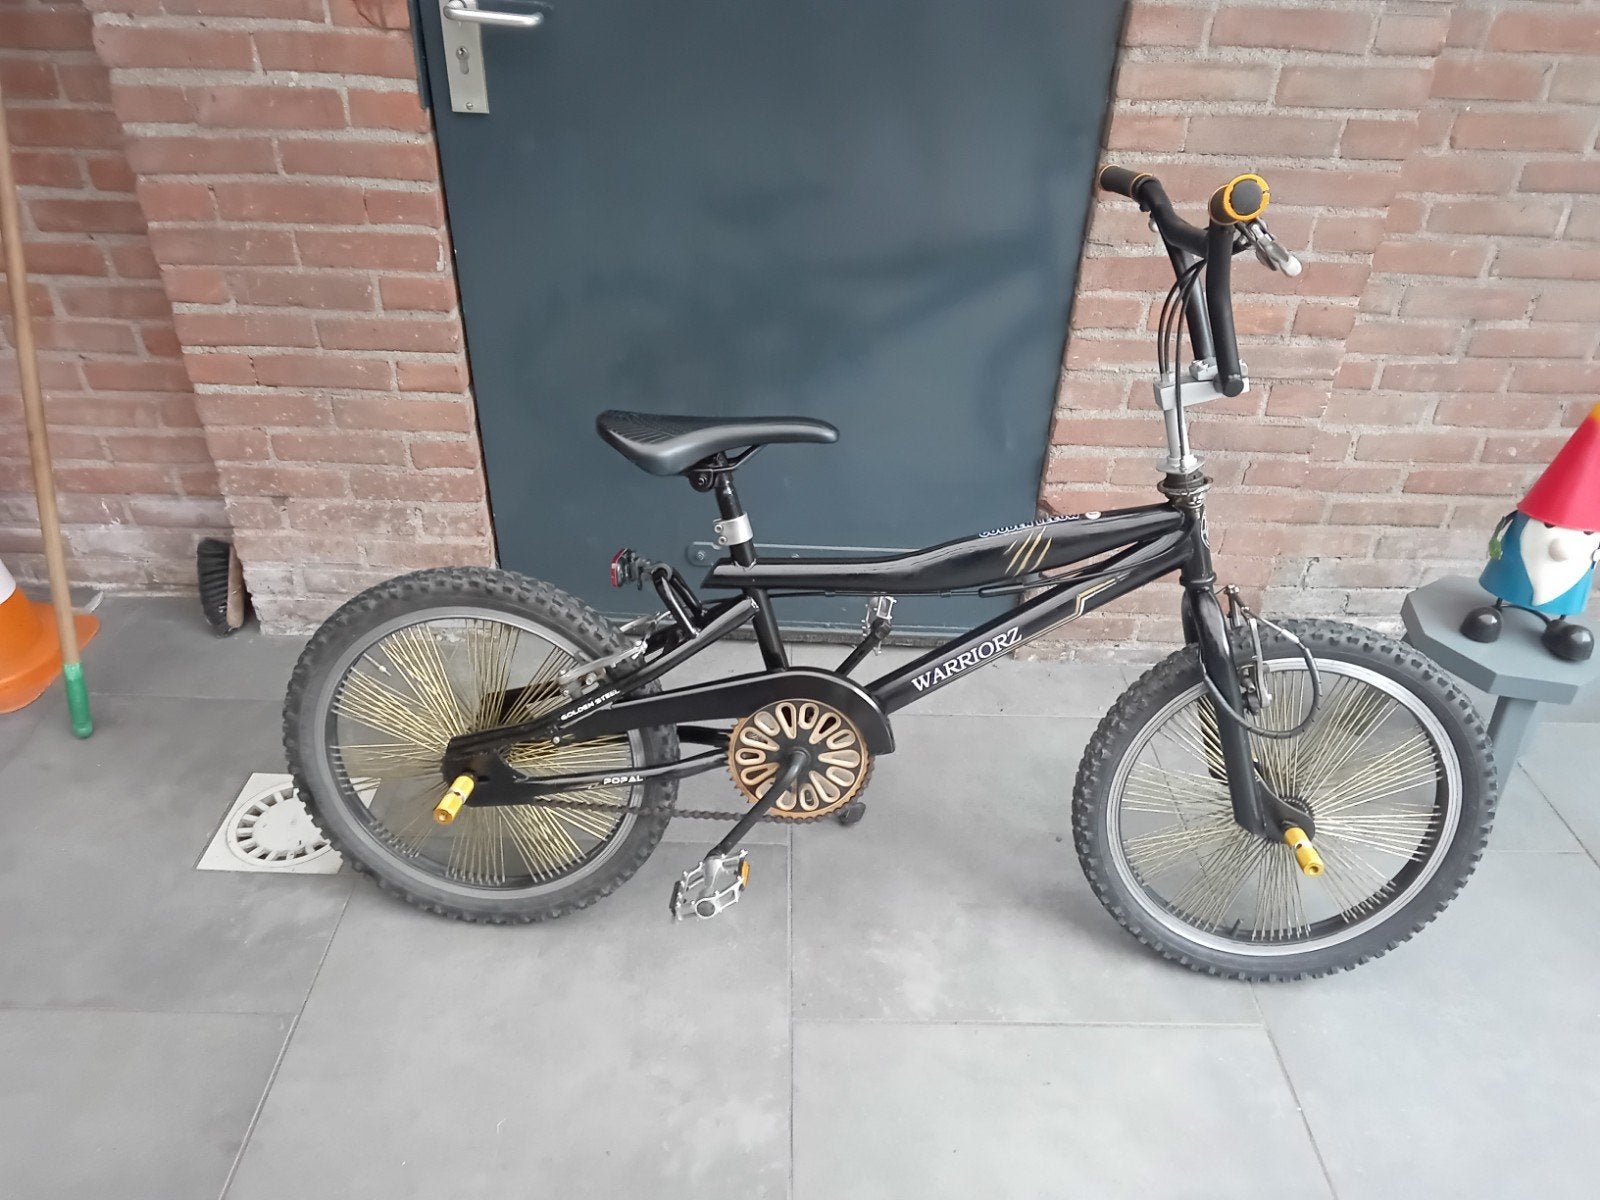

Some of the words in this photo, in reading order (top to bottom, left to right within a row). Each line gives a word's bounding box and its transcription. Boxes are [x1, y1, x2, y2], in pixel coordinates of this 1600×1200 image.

[911, 626, 1022, 692] WARRIORZ
[594, 688, 620, 705] STEEL
[603, 775, 644, 785] POPAL
